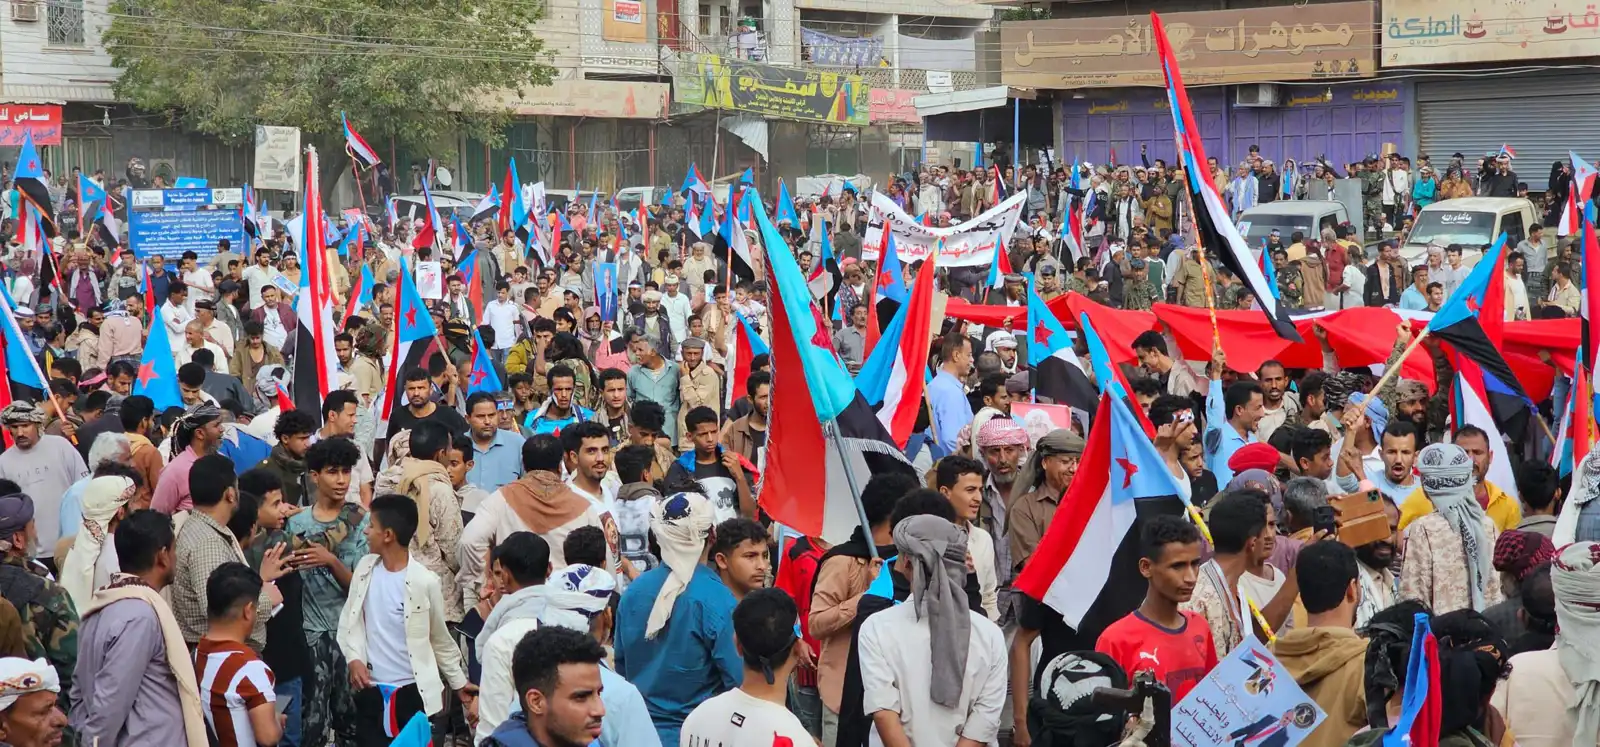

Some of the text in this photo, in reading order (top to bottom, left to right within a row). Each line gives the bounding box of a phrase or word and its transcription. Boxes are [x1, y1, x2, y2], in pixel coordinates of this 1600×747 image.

[1014, 15, 1353, 67] مجوهرات الأصيل
[1388, 14, 1460, 39] الملكة
[13, 107, 50, 125] سامي
[1178, 705, 1224, 746] الانتقالي
[1196, 695, 1230, 729] والمجلس
